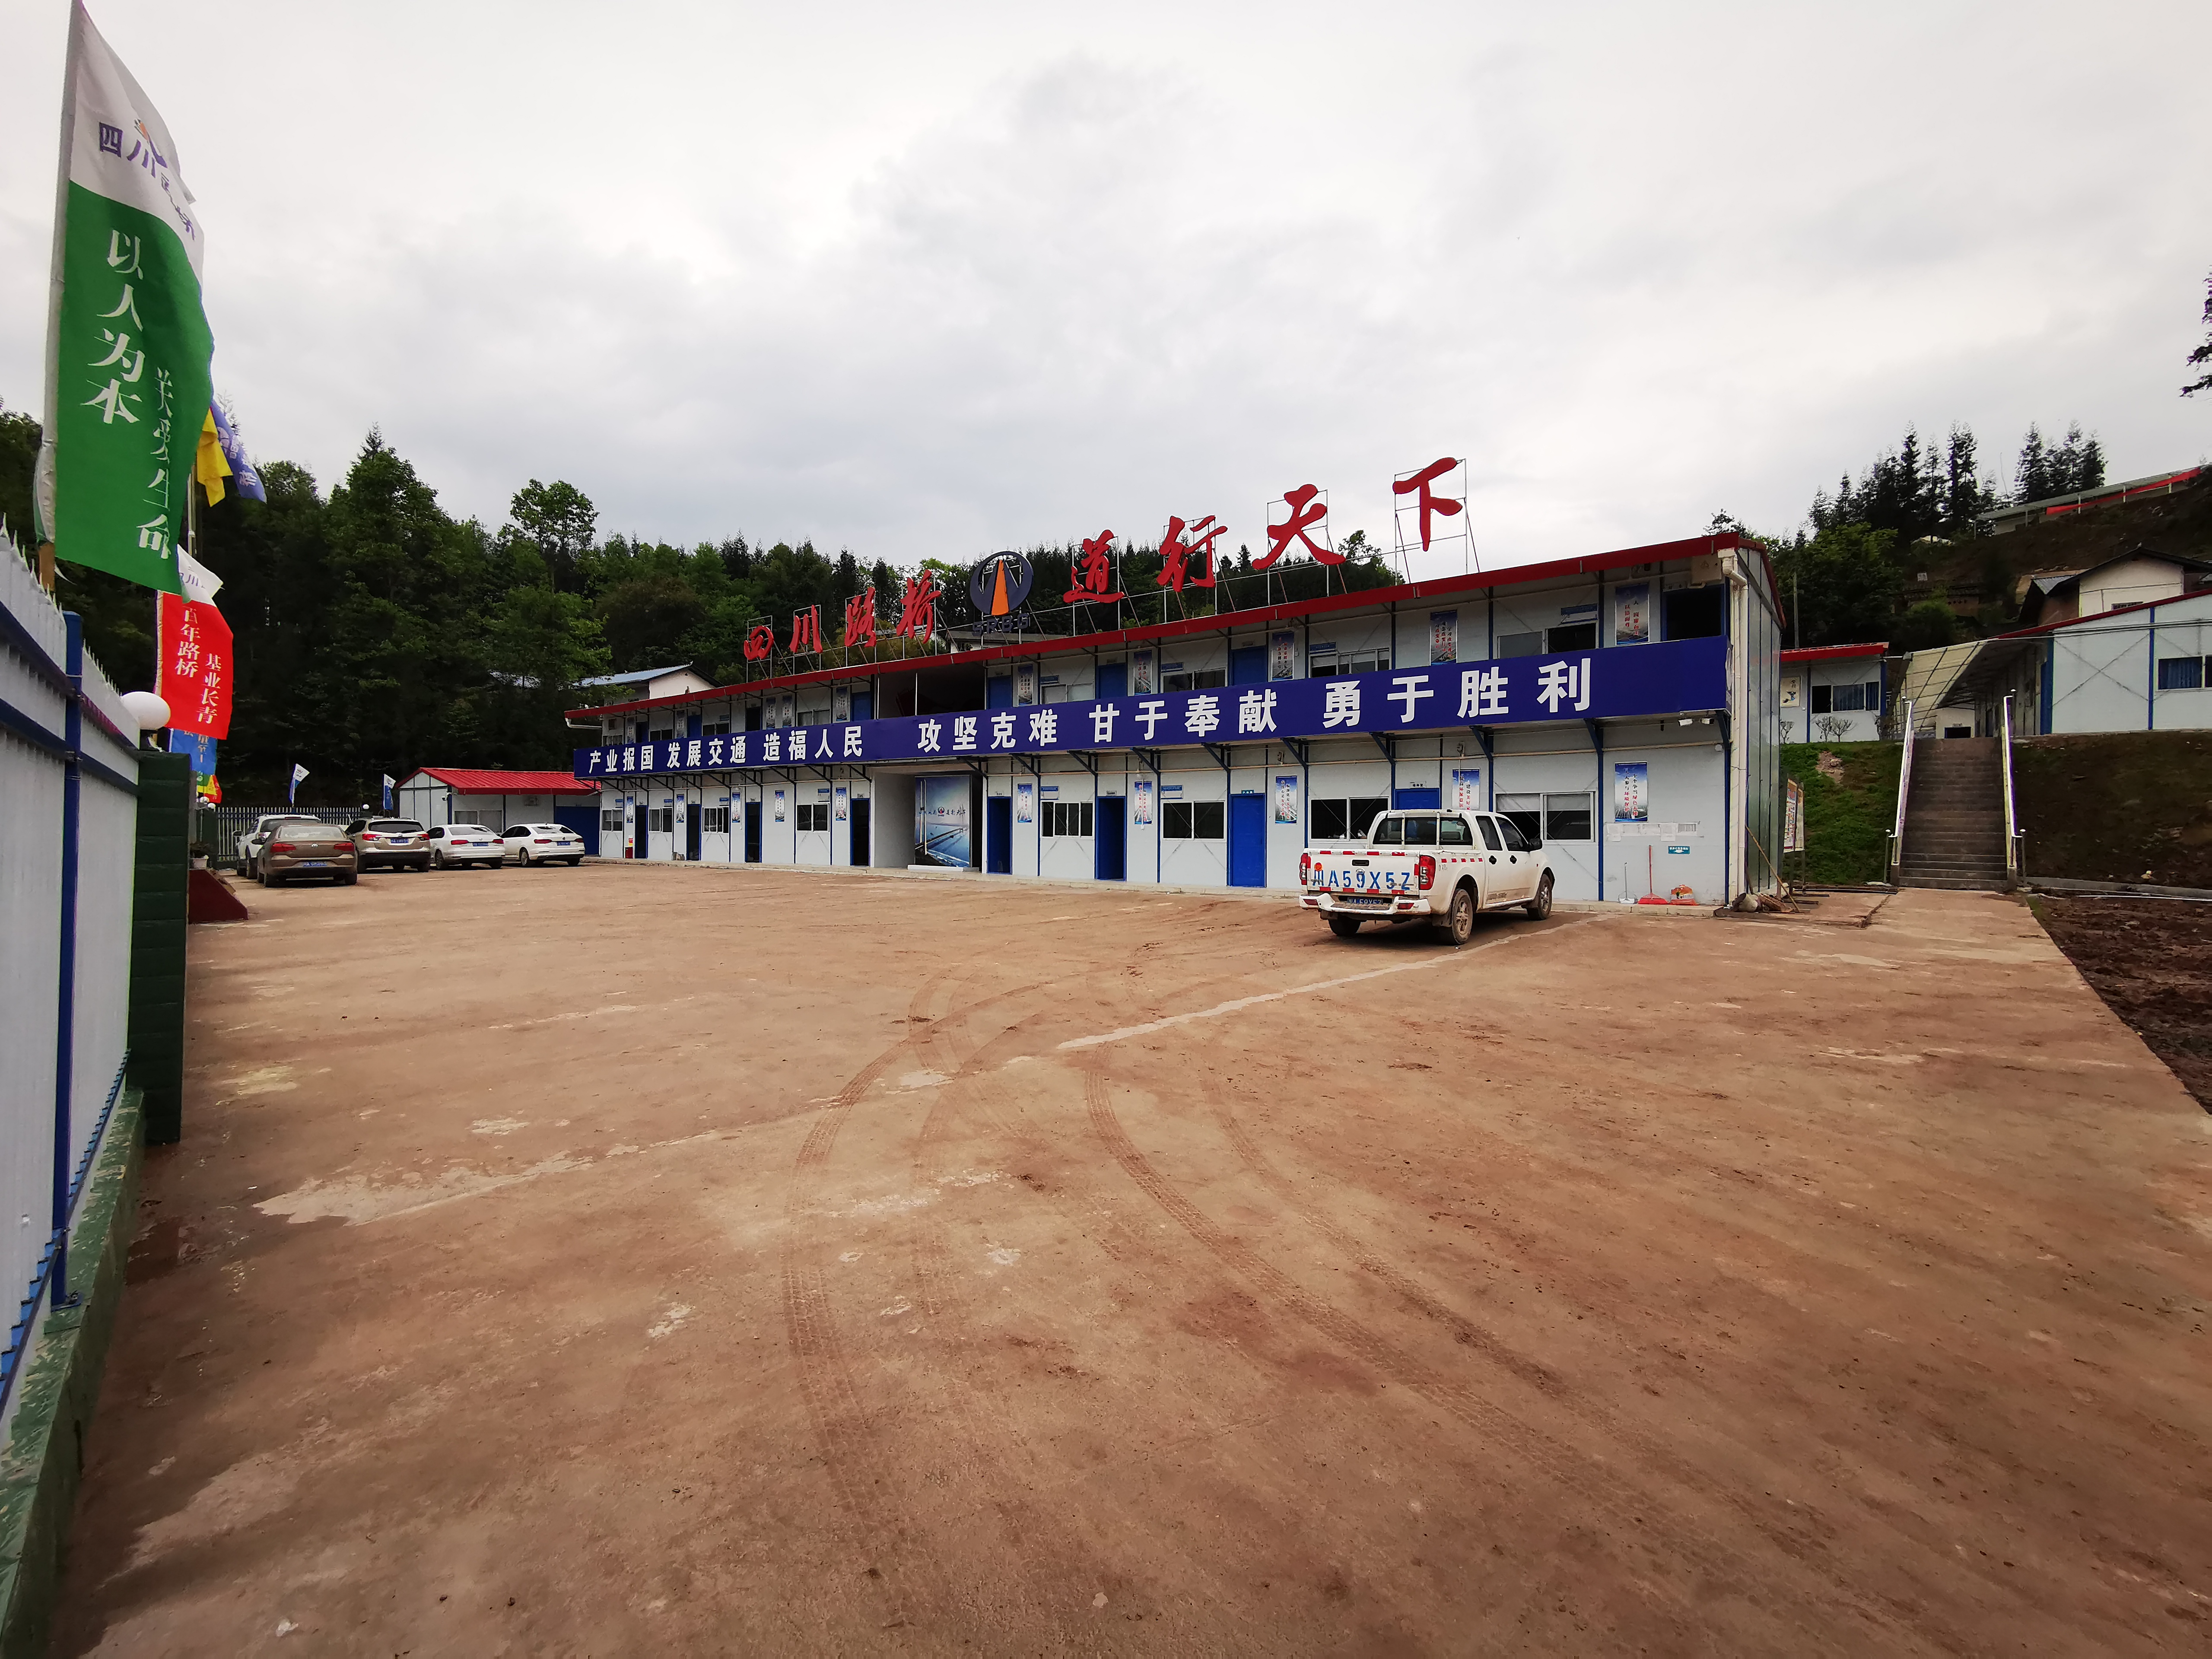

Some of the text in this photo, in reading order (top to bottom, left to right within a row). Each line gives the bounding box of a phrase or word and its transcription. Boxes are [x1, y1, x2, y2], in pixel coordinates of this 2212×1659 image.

[99, 120, 195, 241] 四川
[81, 229, 146, 424] 以人为本
[744, 457, 1463, 660] 四川路桥 道行天下
[175, 606, 200, 678] 百年路桥
[972, 613, 1030, 637] SRBG
[197, 653, 222, 725] 基业长青
[588, 658, 1591, 774] 产业报国 发展交通 造福人民 攻坚克难 甘于奉献 勇于胜利
[1312, 869, 1411, 890] 川A59X5Z
